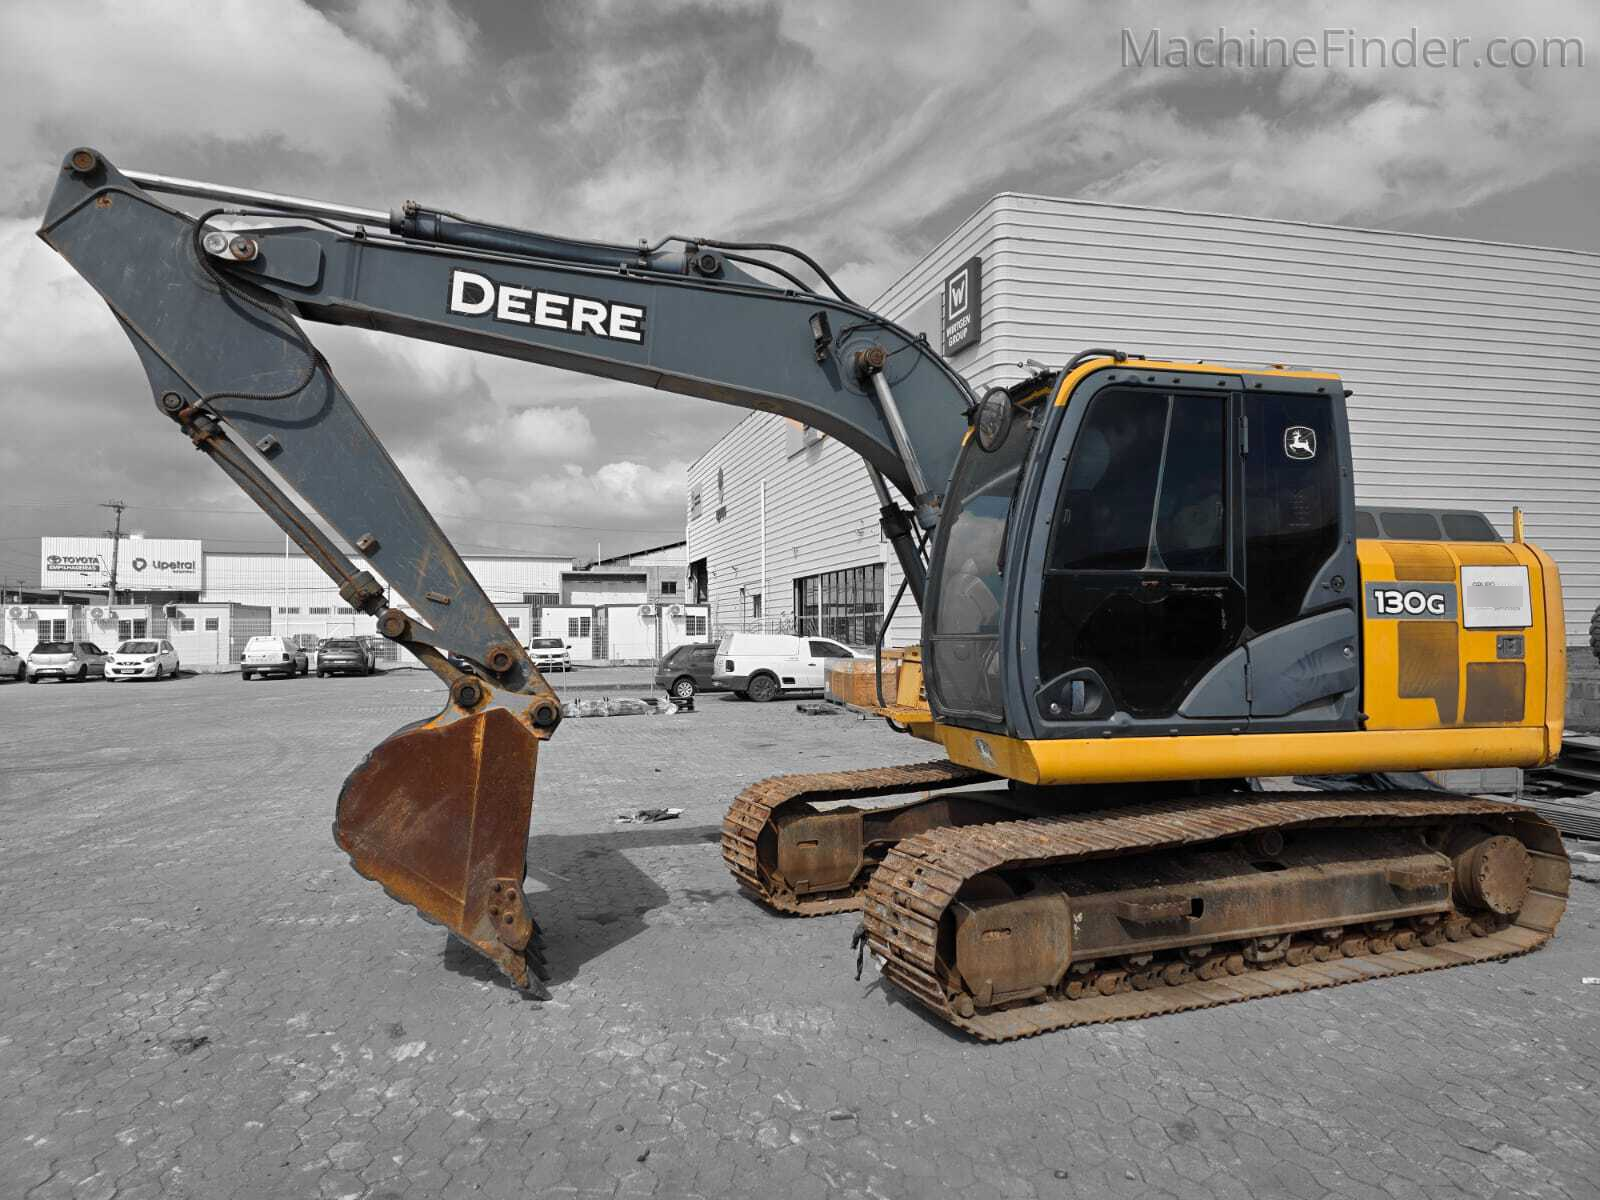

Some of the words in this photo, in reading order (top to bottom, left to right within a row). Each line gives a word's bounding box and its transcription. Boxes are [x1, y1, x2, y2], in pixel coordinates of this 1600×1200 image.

[450, 269, 644, 342] DEERE
[949, 327, 968, 347] GROUP
[62, 556, 99, 564] TOYOTA
[1374, 590, 1445, 615] 130G
